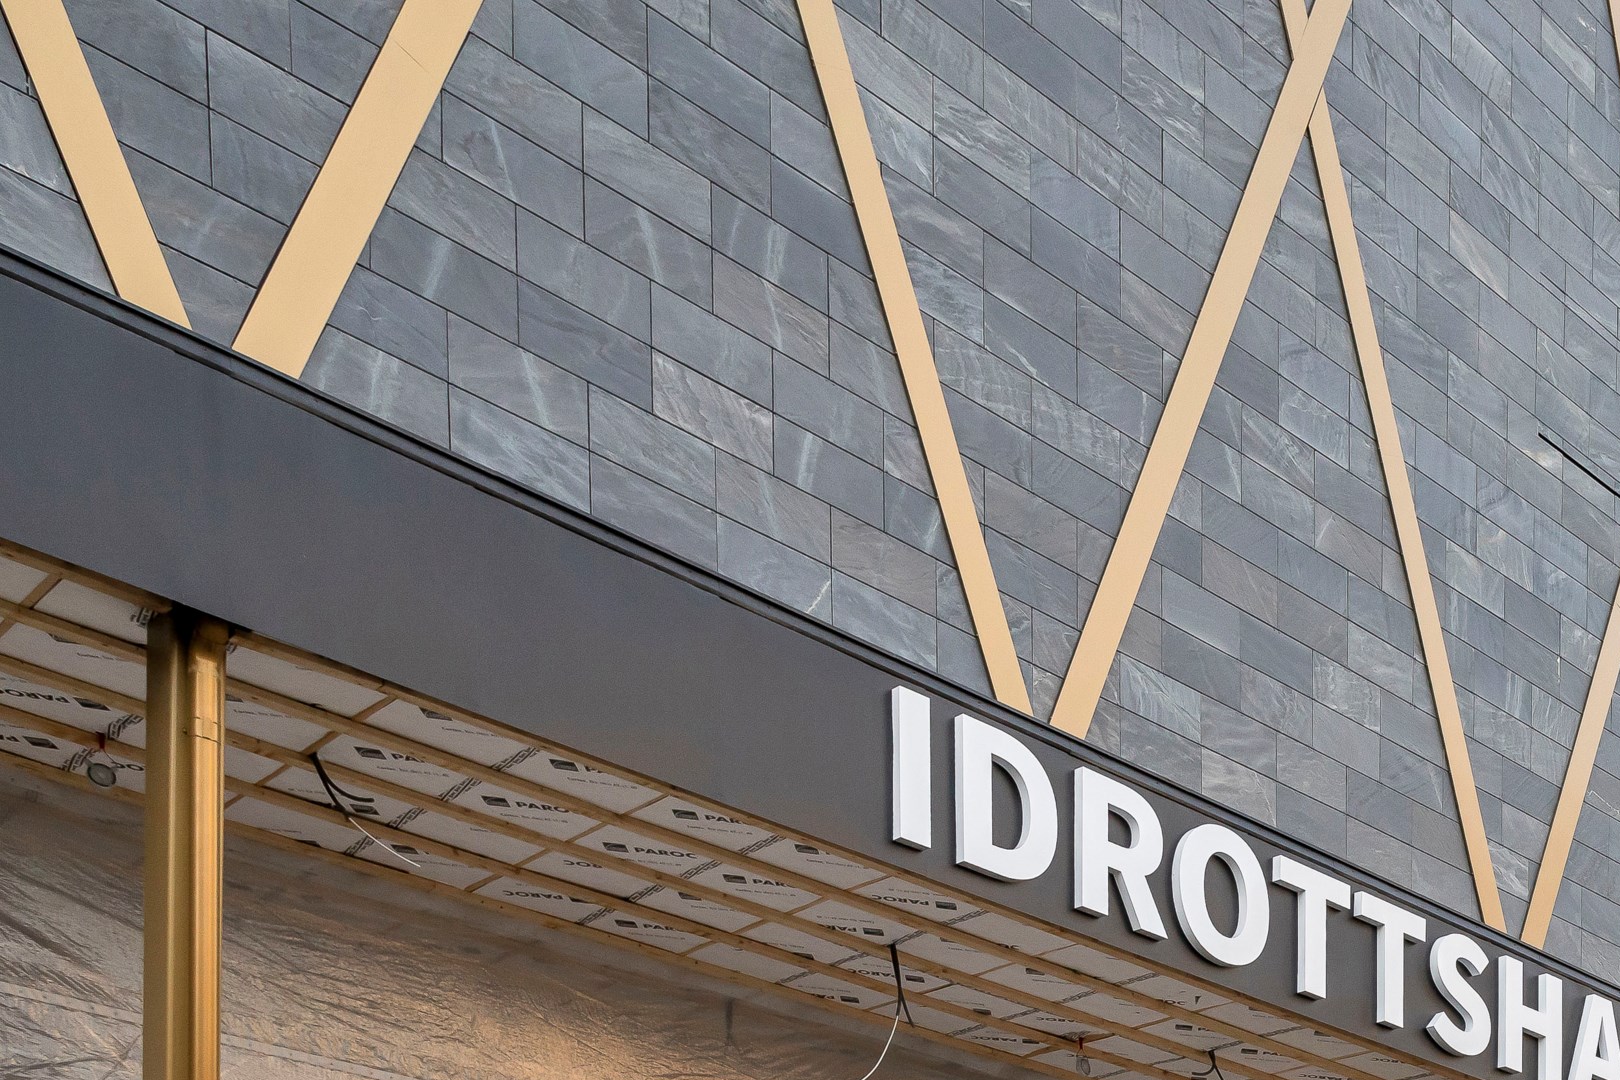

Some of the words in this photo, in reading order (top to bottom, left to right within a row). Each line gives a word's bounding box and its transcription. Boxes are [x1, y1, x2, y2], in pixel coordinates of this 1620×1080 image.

[0, 688, 70, 704] PARO
[515, 801, 571, 814] PARO
[704, 814, 742, 825] PAR
[634, 846, 698, 859] PAROC
[502, 889, 563, 900] PAROC
[871, 894, 930, 906] PAROC
[848, 967, 897, 978] AROC
